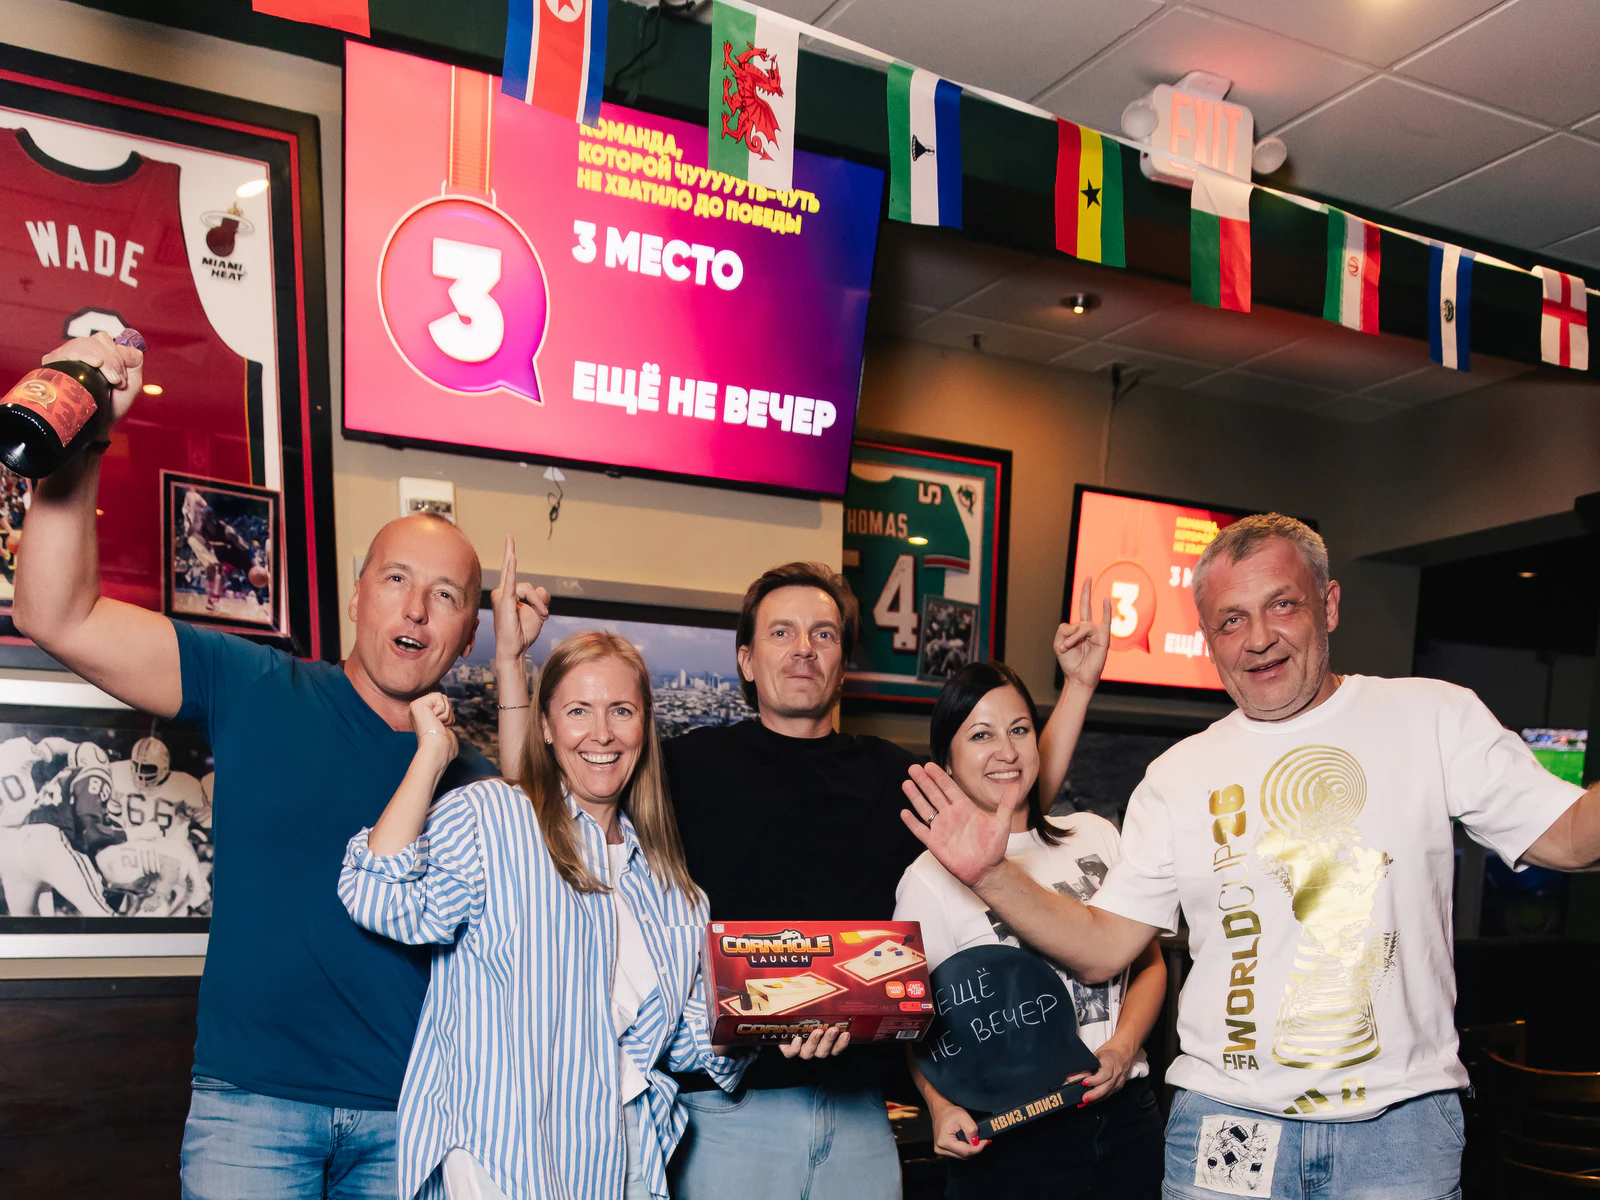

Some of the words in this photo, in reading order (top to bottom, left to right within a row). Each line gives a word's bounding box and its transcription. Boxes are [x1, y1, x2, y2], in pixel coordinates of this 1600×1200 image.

[1169, 92, 1242, 176] EXIT
[578, 140, 672, 181] КОТОРОЙ
[577, 167, 602, 192] НЕ
[604, 172, 693, 211] ХВАТИЛО
[693, 192, 724, 218] ДО
[725, 199, 802, 235] ПОБЕДЫ
[25, 220, 144, 288] WADE
[201, 256, 242, 271] MIAMI
[571, 219, 597, 263] 3
[605, 226, 744, 291] МЕСТО
[211, 268, 244, 282] HEAT
[428, 237, 504, 362] 3
[573, 360, 662, 415] ЕЩЁ
[667, 376, 718, 421] НЕ
[723, 384, 837, 437] ВЕЧЕР
[845, 508, 909, 539] HOMAS
[1169, 565, 1181, 587] 3
[1110, 581, 1139, 638] 3
[1164, 630, 1205, 659] ЕЩЁ
[723, 935, 831, 953] CORNHOLE
[751, 955, 809, 963] LAUNCH
[935, 967, 995, 1016] ЕЩЁ
[927, 1030, 962, 1062] НЕ
[970, 994, 1058, 1043] ВЕЧЕР
[1222, 1052, 1260, 1071] FIFA
[990, 1111, 1027, 1132] КВИЗ,
[1025, 1093, 1064, 1118] ПЛИЗ!
